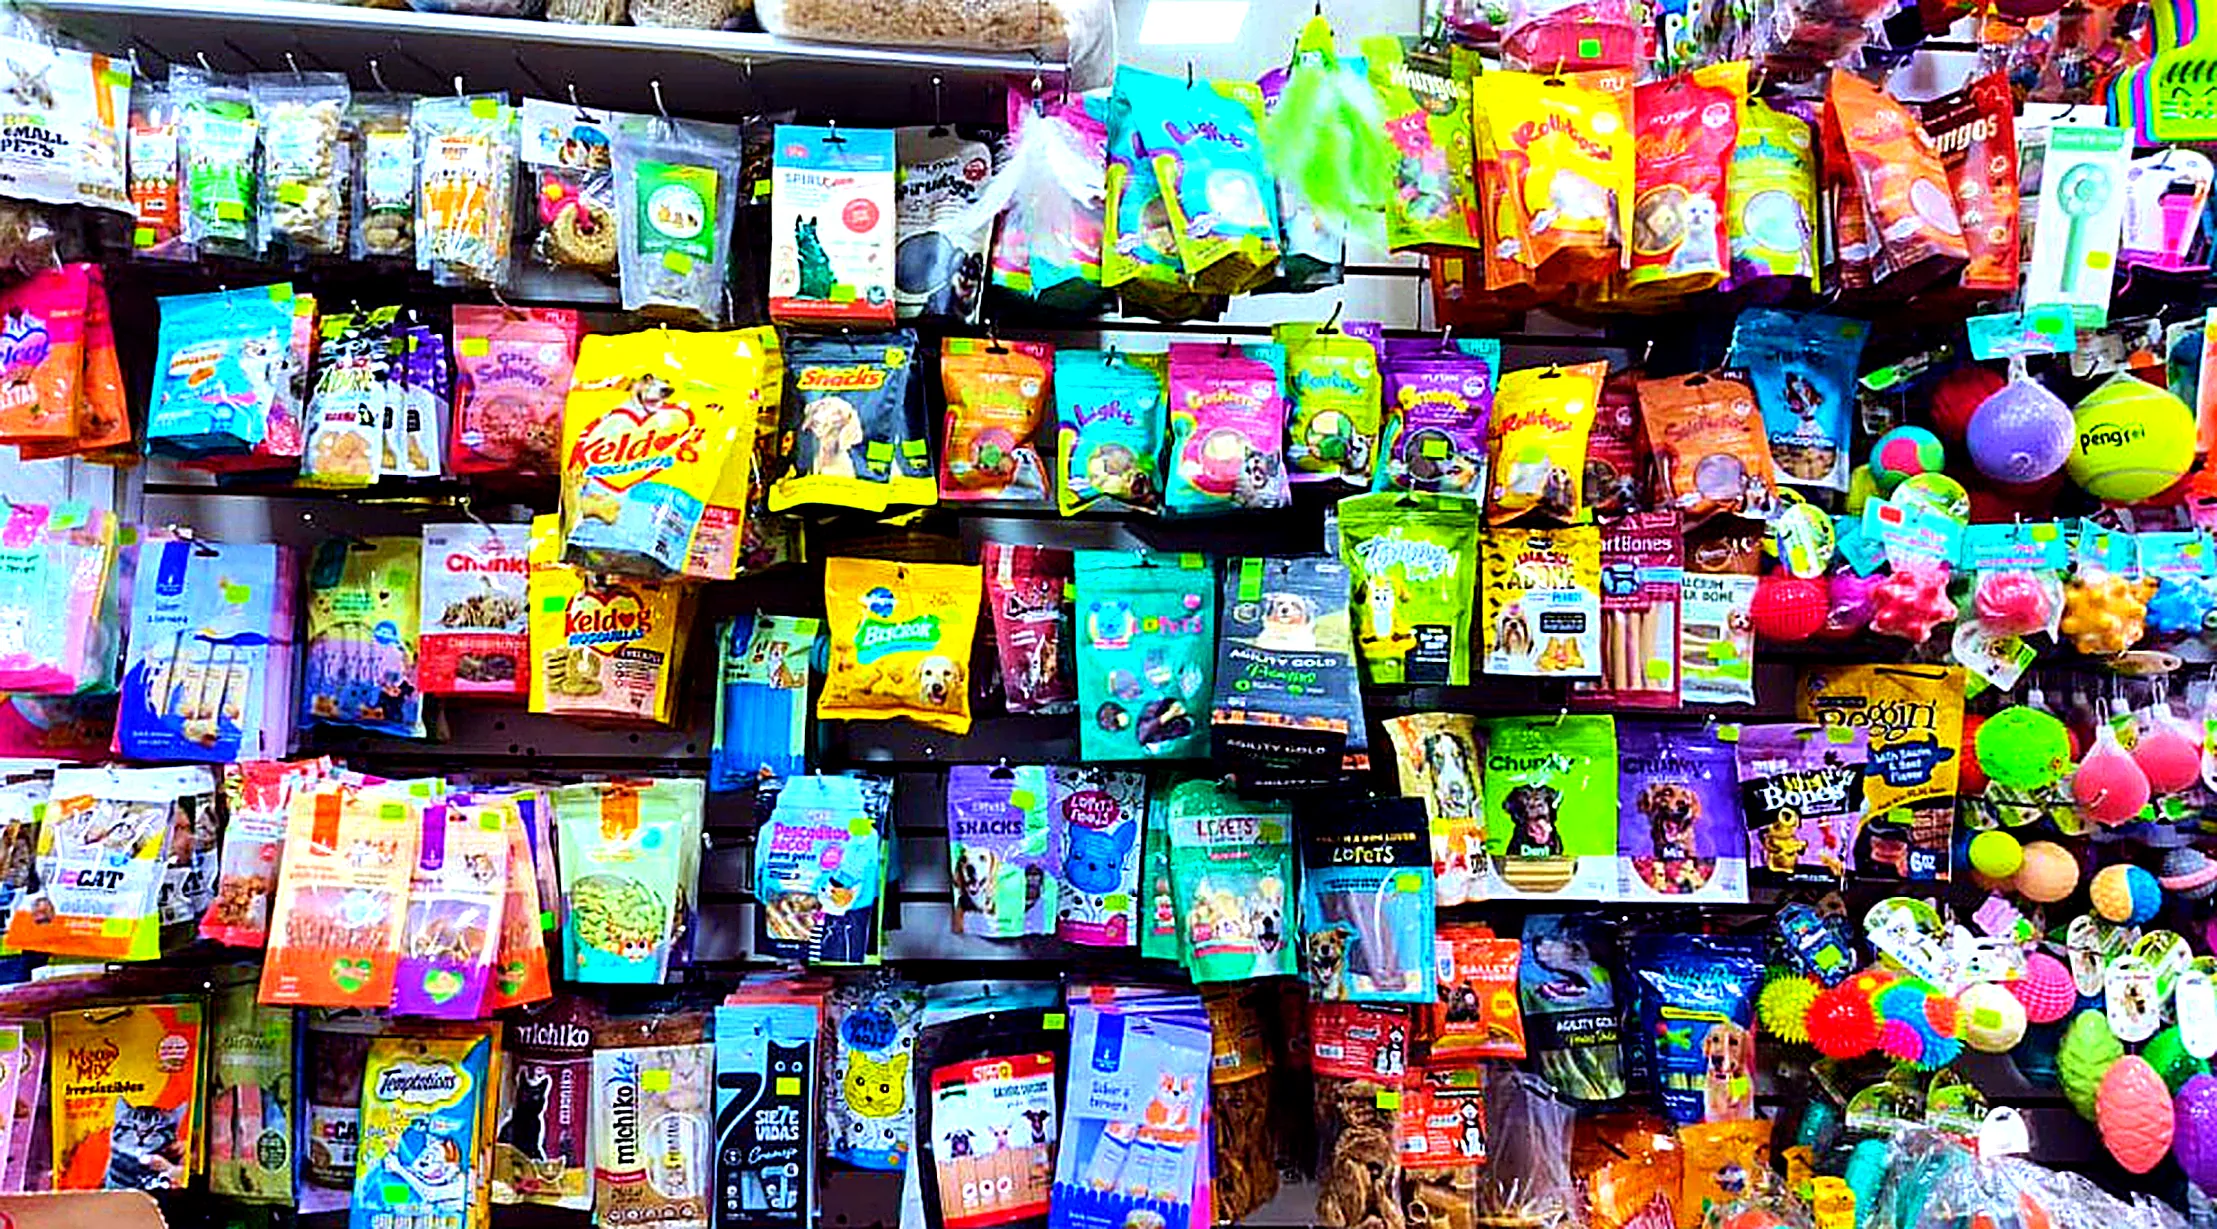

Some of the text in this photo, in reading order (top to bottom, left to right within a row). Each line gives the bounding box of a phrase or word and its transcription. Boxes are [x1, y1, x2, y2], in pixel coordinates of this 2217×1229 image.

[803, 368, 884, 388] Snacks
[565, 605, 652, 637] Keldog
[1291, 658, 1337, 668] GOLD
[1488, 752, 1575, 775] Chunky
[956, 820, 1022, 835] SNACKS
[77, 869, 125, 889] CAT
[65, 1080, 145, 1096] Irresistibles
[378, 1066, 457, 1099] Temptations
[754, 1105, 800, 1126] SIE7E
[754, 1125, 800, 1142] VIDAS
